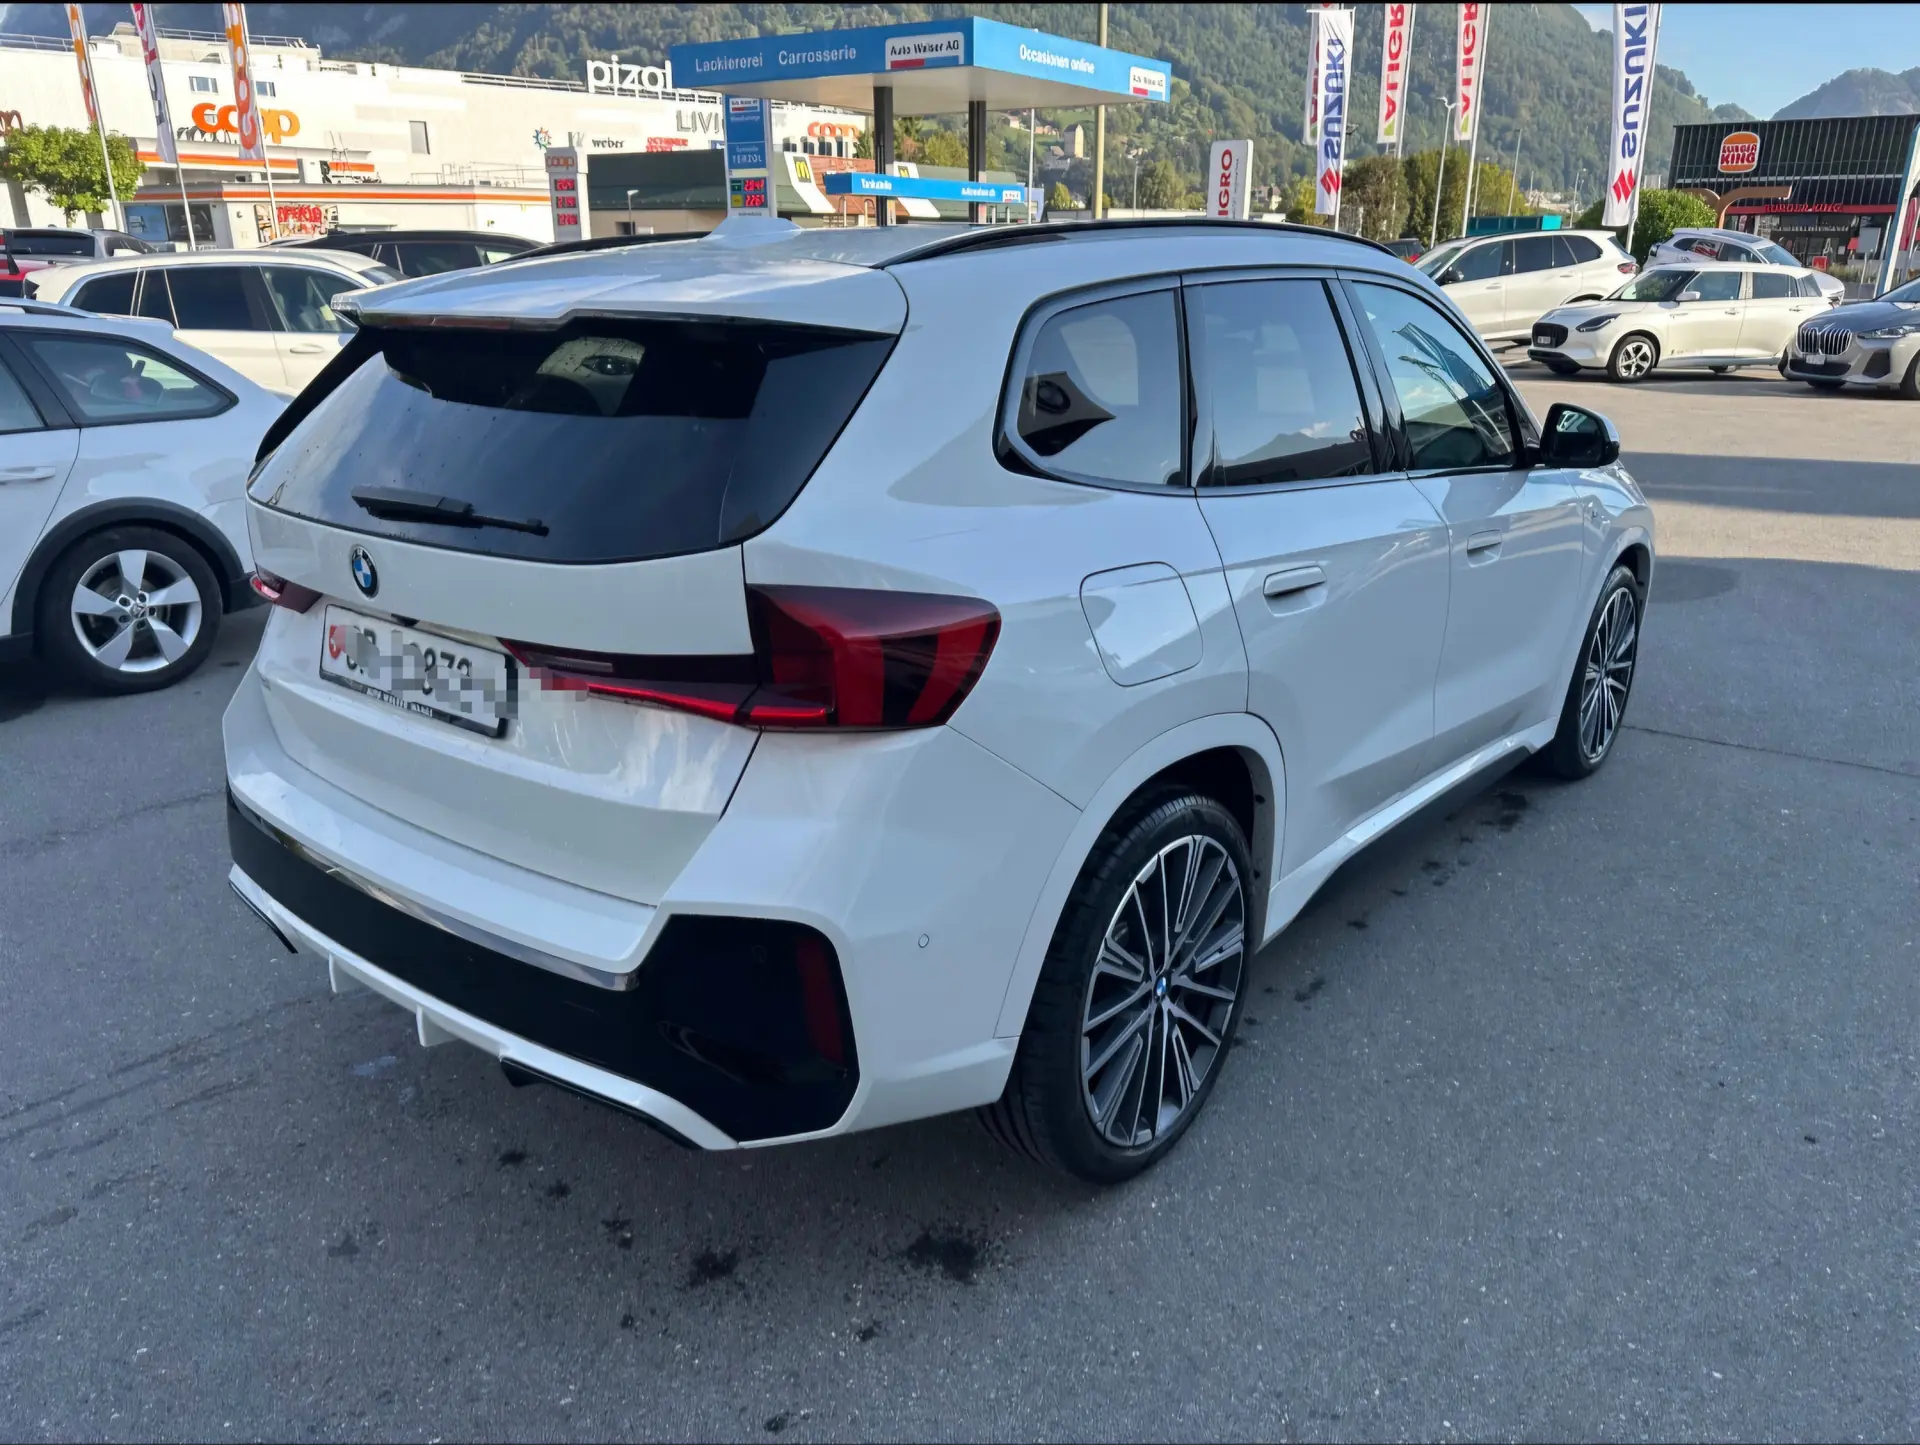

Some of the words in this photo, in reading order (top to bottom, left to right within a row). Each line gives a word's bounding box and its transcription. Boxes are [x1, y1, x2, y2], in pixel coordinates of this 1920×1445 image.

[778, 45, 857, 65] Carrosserie
[1020, 43, 1069, 69] Occasionen
[586, 54, 673, 93] pizol
[675, 110, 725, 134] LIVI
[1720, 152, 1756, 165] KING
